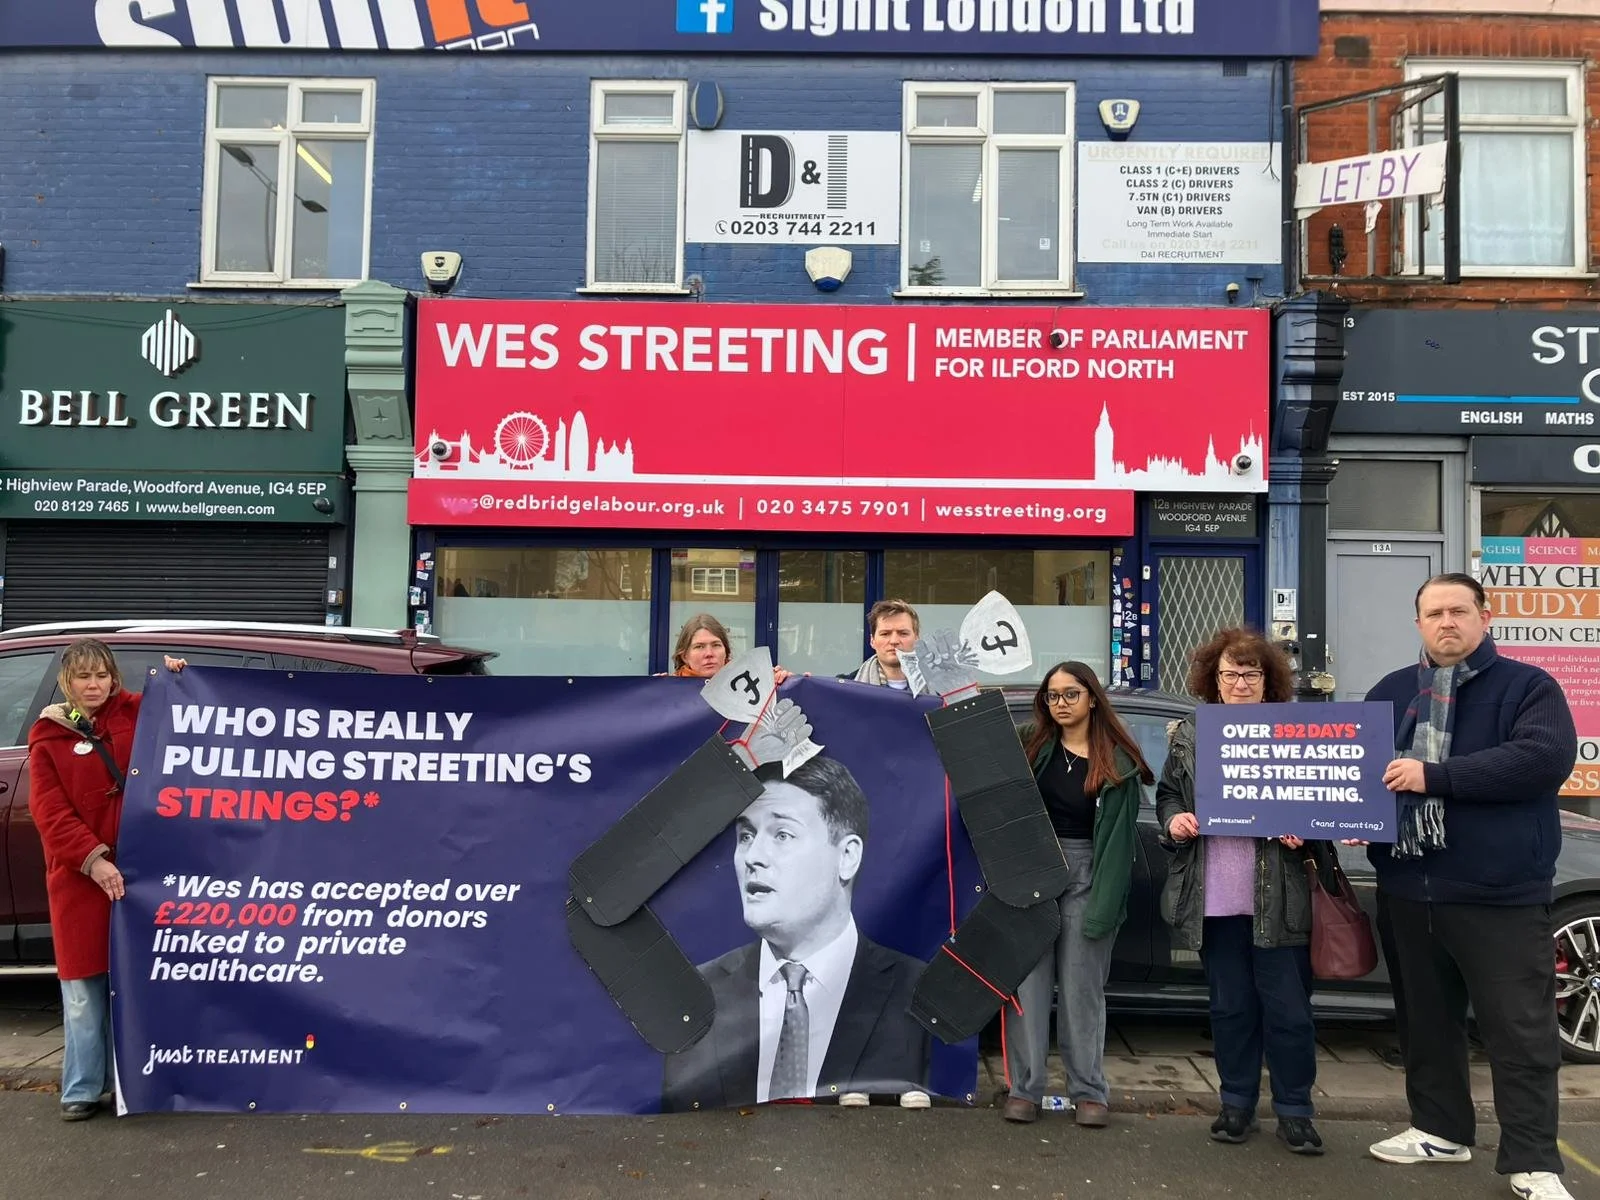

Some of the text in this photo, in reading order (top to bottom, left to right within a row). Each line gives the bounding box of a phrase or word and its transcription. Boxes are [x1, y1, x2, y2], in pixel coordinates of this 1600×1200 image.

[1088, 146, 1269, 159] URGENTLY REQUIRED
[801, 160, 821, 185] &
[1120, 166, 1240, 177] CLASS 1 (C+E) DRIVERS
[1319, 152, 1421, 204] LET BY
[1126, 179, 1234, 190] CLASS 2 (C) DRIVERS
[1129, 192, 1231, 203] 7.5TN (C1) DRIVERS
[1137, 206, 1223, 217] VAN (B) DRIVERS
[731, 221, 876, 236] 0203 744 2211
[1127, 220, 1233, 229] Long Term Work Available
[1147, 230, 1213, 239] Immediate Start
[1101, 239, 1127, 249] Call
[1141, 251, 1224, 259] D&I RECRUITMENT
[935, 327, 1248, 350] MEMBER OF PARLIAMENT
[436, 323, 888, 375] WES STREETING
[935, 358, 1174, 379] FOR ILFORD NORTH
[1342, 391, 1395, 402] EST 2015
[19, 390, 310, 430] BELL GREEN
[1461, 411, 1595, 425] ENGLISH MATHS
[6, 478, 73, 494] Highview
[77, 479, 132, 495] Parade,
[133, 480, 204, 494] Woodford
[207, 481, 265, 496] Avenue,
[269, 482, 294, 495] IG4
[297, 483, 327, 496] 5EP
[34, 500, 275, 517] 020 8129 7465 www.bellgreen.com
[757, 499, 794, 515] 020
[801, 500, 853, 516] 3475
[860, 501, 910, 516] 7901
[935, 503, 1107, 523] wesstreeting.org
[1173, 502, 1215, 510] HIGHVIEW
[1219, 503, 1253, 511] PARADE
[1158, 513, 1248, 522] WOODFORD AVENUE
[1185, 524, 1220, 533] IG4 5EP
[1374, 543, 1391, 552] 13A
[1528, 546, 1577, 556] SCIENCE
[1481, 566, 1547, 586] WHY
[1122, 611, 1137, 620] 12B
[1523, 655, 1545, 664] range
[1557, 654, 1600, 662] individual
[1561, 665, 1588, 673] child's
[171, 705, 473, 741] WHO IS REALLY
[1222, 724, 1271, 739] OVER
[1273, 723, 1305, 739] 392
[1220, 744, 1365, 760] SINCE WE ASKED
[162, 745, 593, 783] PULLING STREETING'S
[1222, 764, 1361, 781] WES STREETING
[1222, 785, 1364, 803] FOR A MEETING.
[1339, 821, 1384, 831] counting)
[249, 876, 304, 900] has
[311, 878, 450, 905] accepted
[455, 883, 520, 902] over
[154, 901, 487, 929] £220,000 from donors
[152, 929, 406, 961] linked to private
[150, 958, 324, 984] healthcare.
[143, 1044, 304, 1075] just TREATMENT
